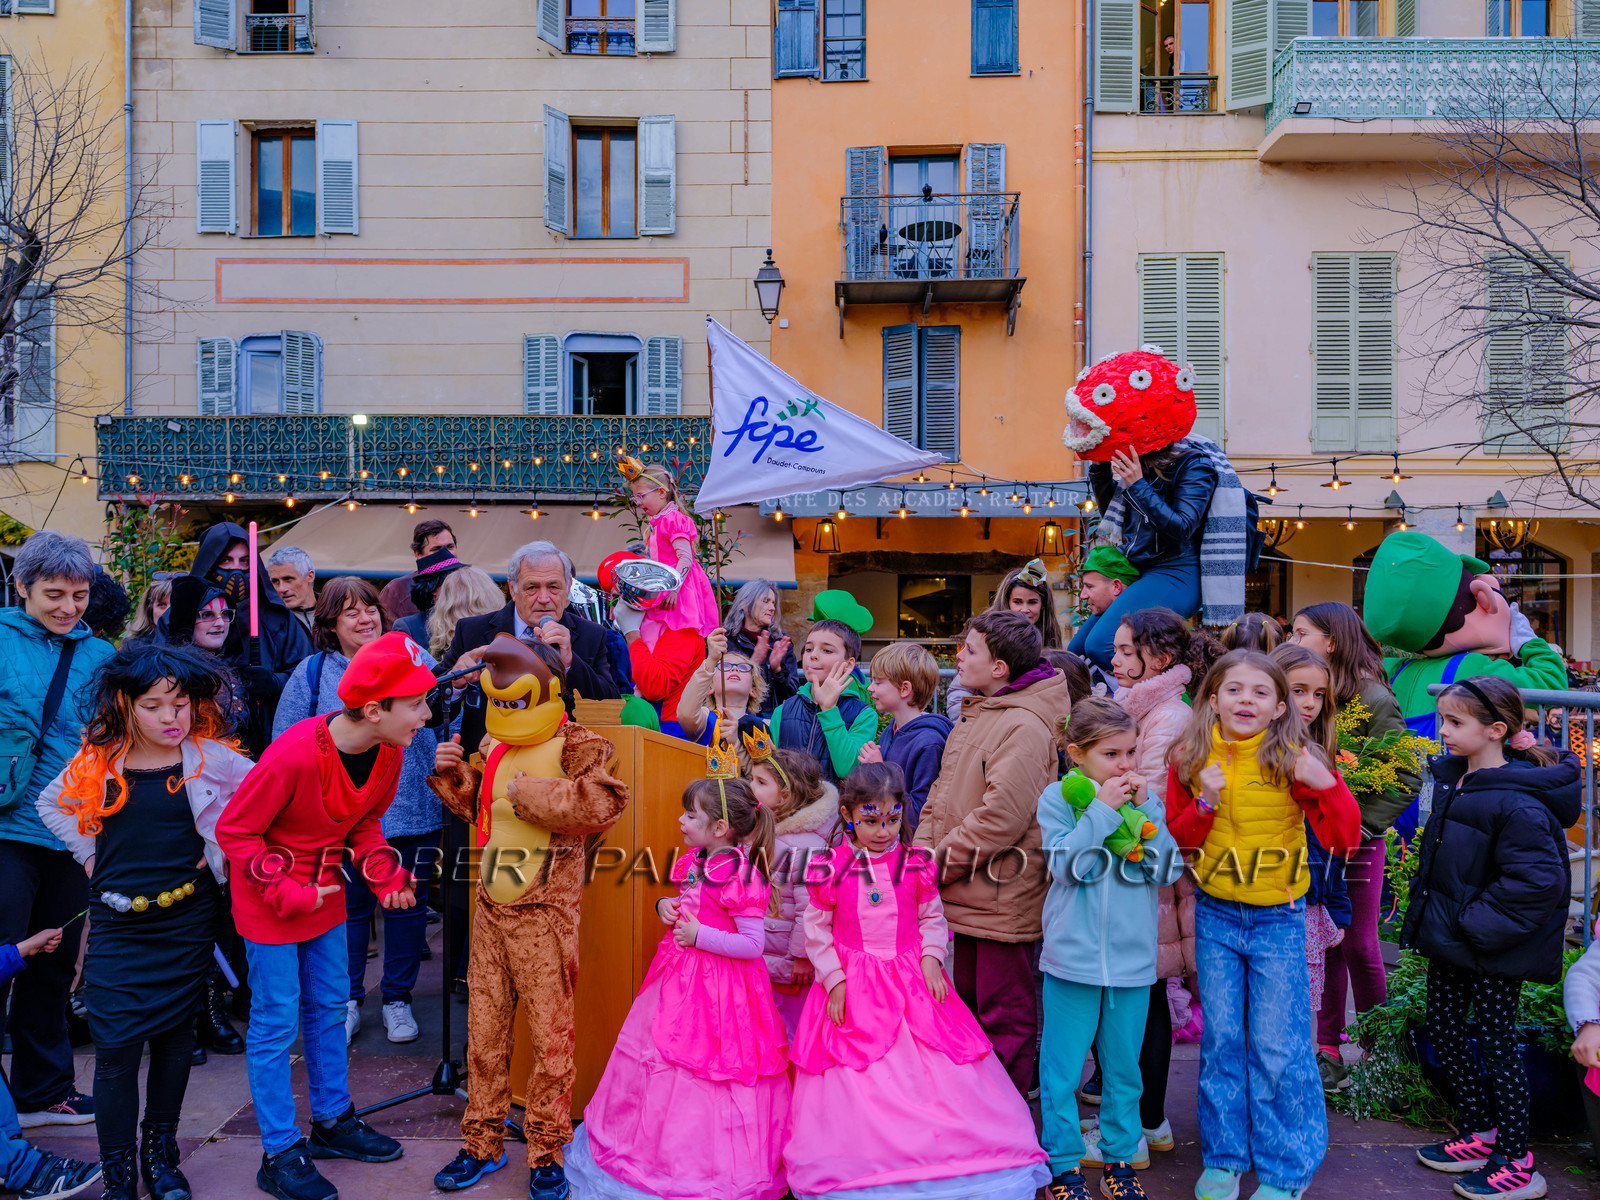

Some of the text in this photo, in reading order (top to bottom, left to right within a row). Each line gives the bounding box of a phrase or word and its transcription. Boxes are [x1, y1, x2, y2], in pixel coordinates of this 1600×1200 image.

[721, 396, 825, 464] fcpe
[827, 491, 867, 508] DES
[877, 491, 972, 507] ARCADES
[989, 490, 1092, 507] RETAUR
